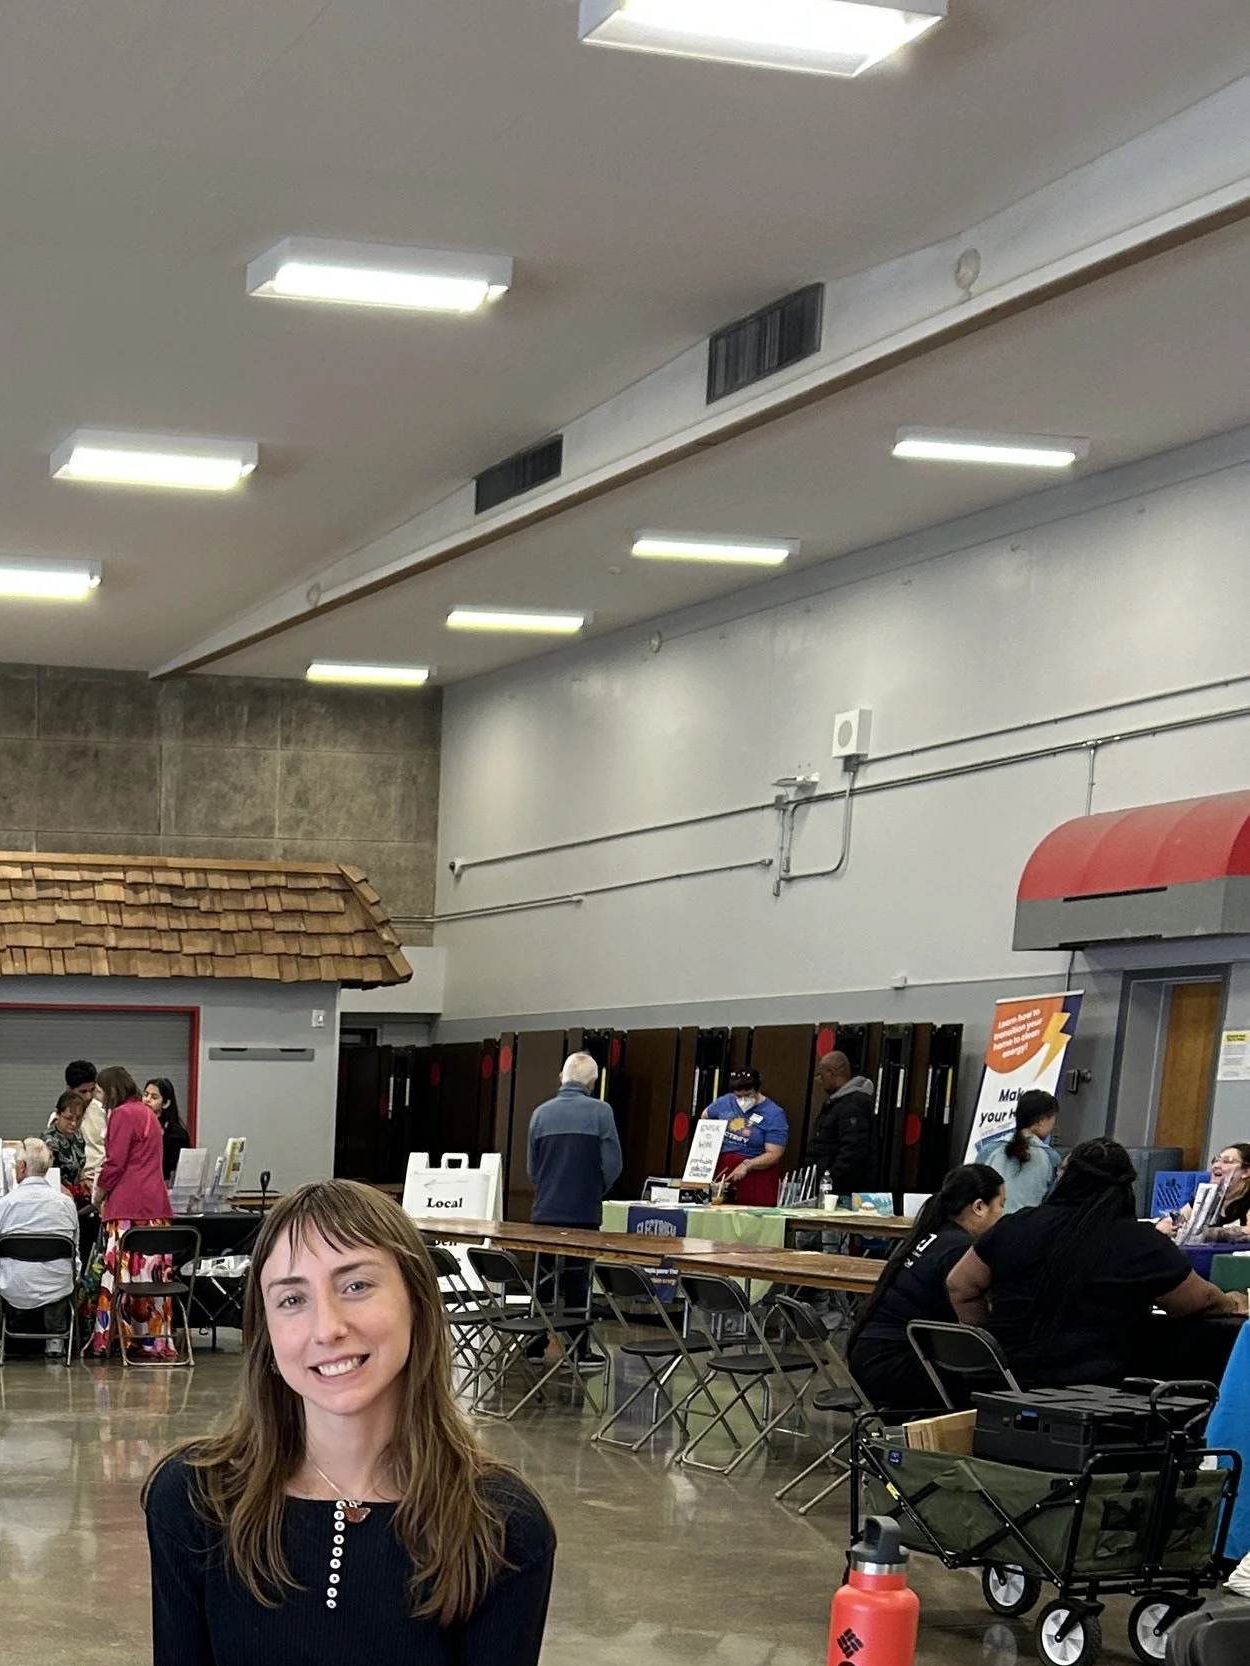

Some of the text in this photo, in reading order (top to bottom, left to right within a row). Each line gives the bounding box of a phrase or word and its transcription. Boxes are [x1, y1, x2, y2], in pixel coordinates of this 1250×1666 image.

[999, 1088, 1023, 1102] Mak
[979, 1110, 1007, 1127] your
[426, 1197, 463, 1208] Local
